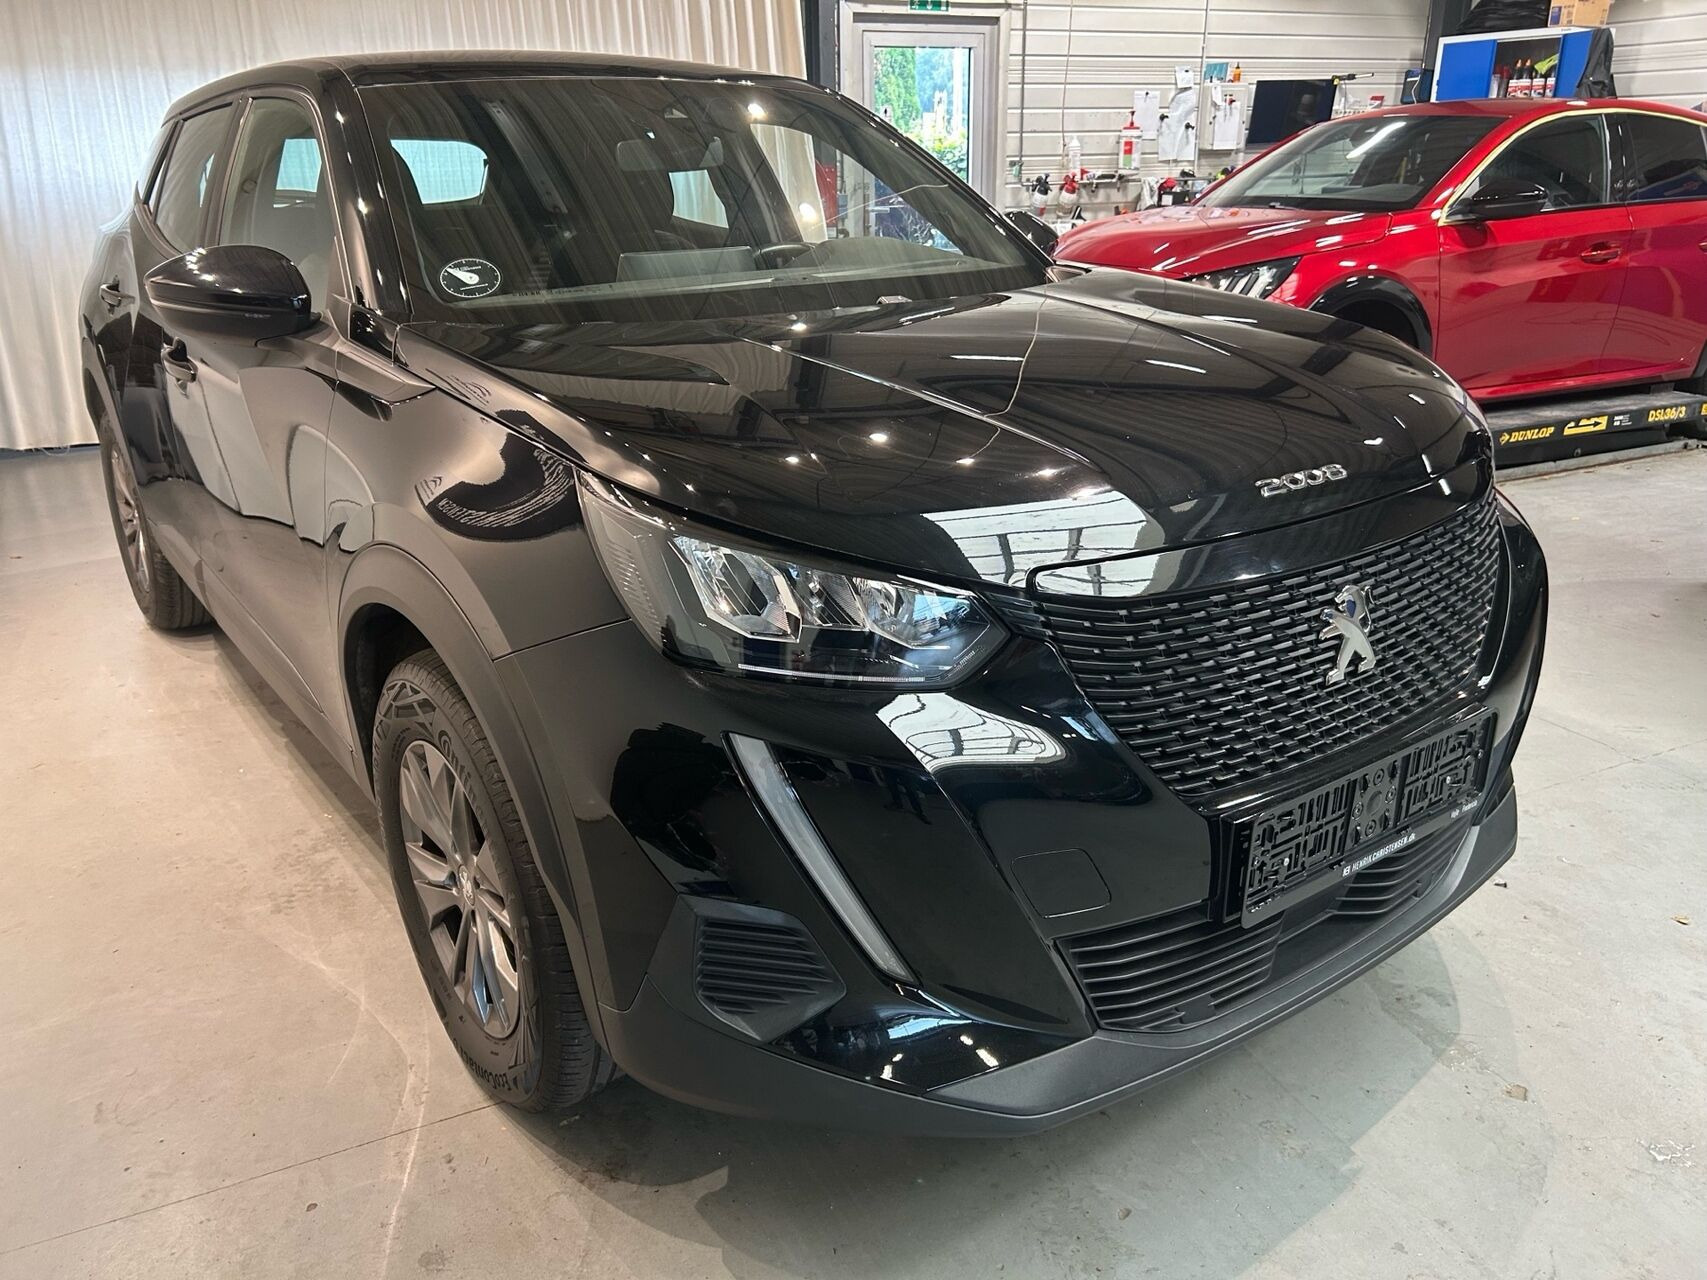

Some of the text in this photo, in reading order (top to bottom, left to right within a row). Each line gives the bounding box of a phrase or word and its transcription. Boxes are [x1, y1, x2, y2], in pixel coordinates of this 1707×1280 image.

[1648, 406, 1686, 422] DSL36/3
[1509, 427, 1555, 443] DUNLOP
[1255, 463, 1347, 498] 2008
